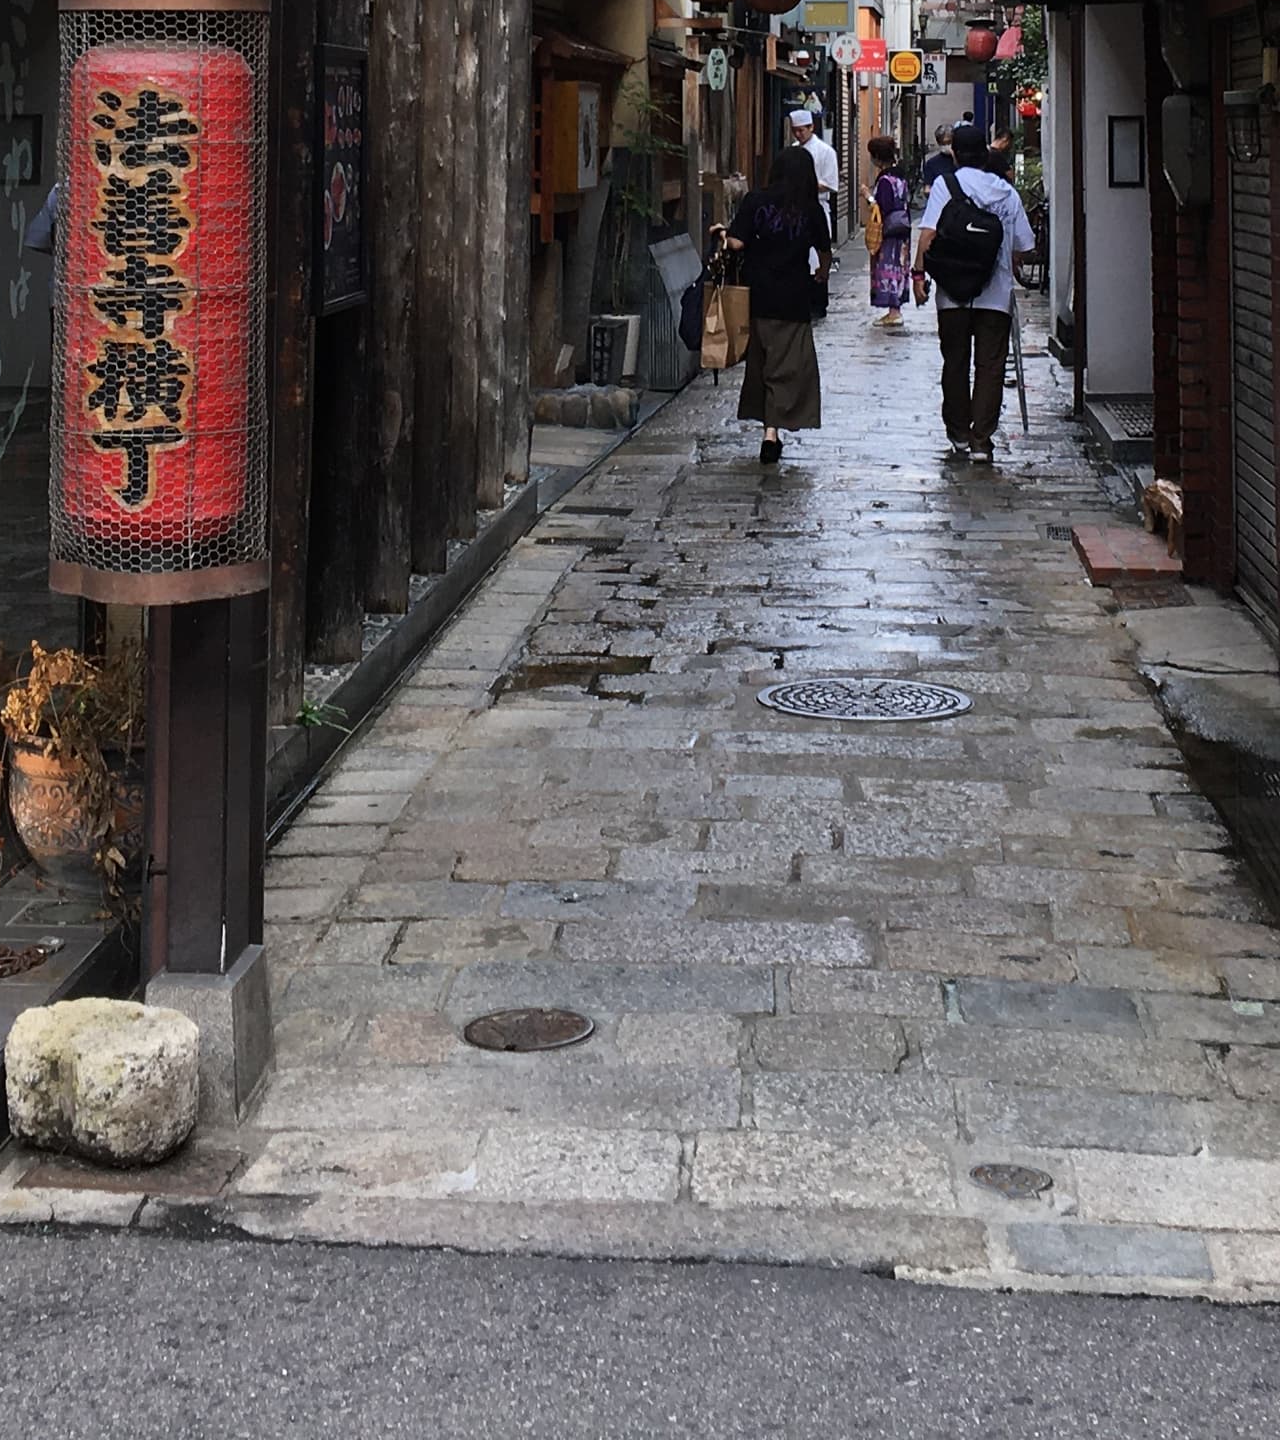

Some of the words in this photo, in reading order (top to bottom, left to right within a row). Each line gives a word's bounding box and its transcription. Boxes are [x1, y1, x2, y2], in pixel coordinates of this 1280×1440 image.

[87, 88, 199, 507] 法善寺横丁
